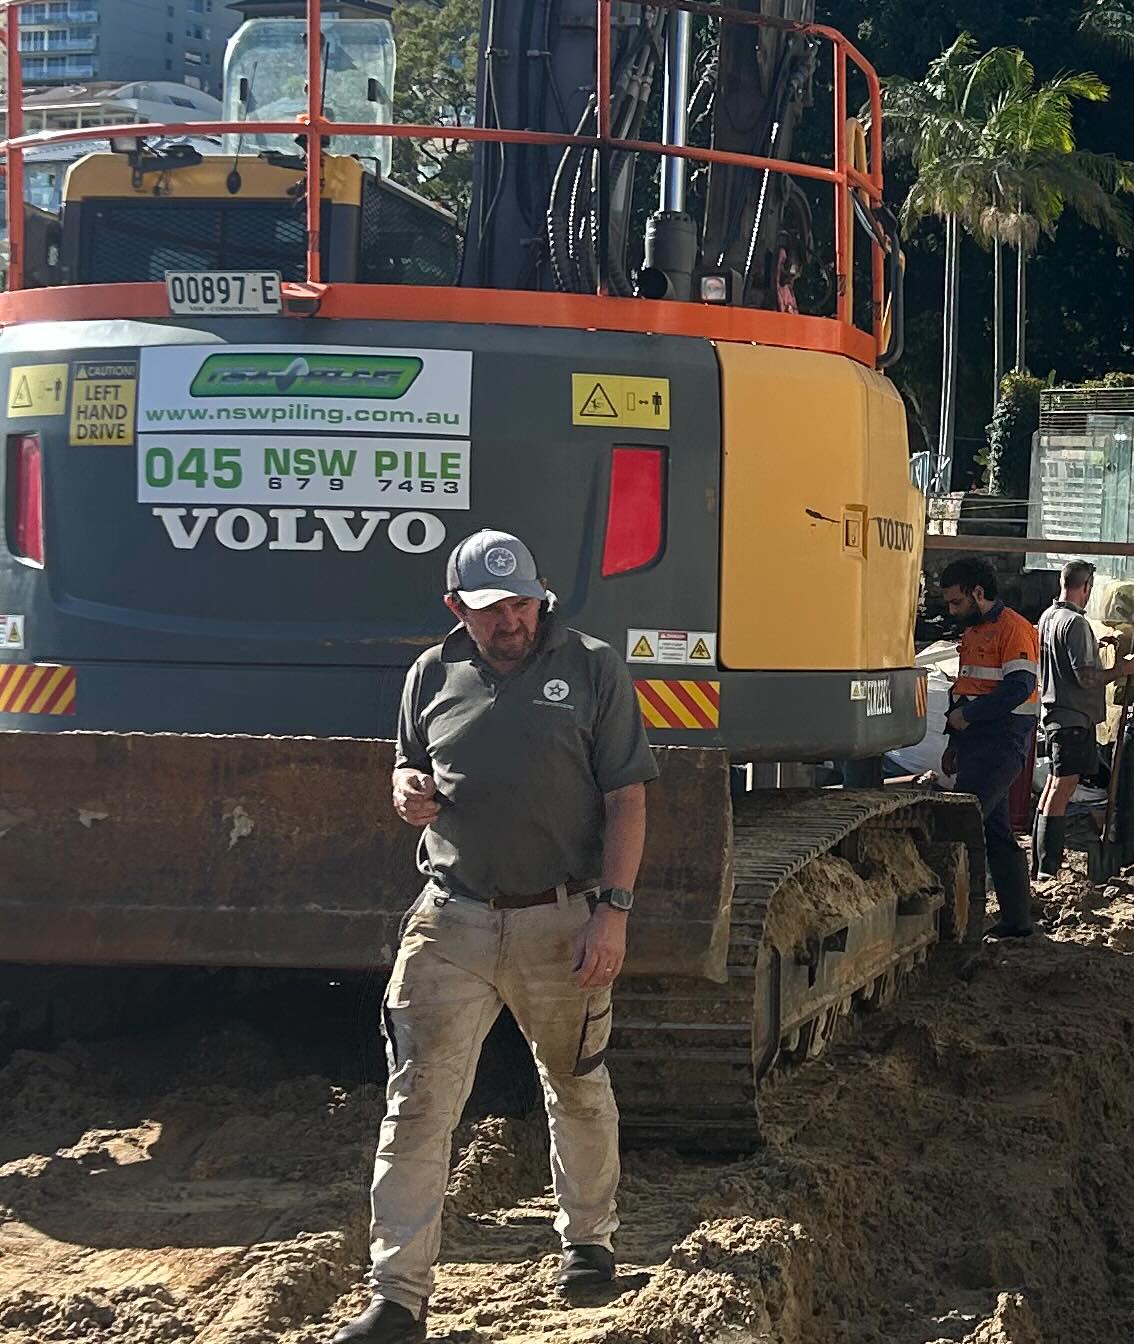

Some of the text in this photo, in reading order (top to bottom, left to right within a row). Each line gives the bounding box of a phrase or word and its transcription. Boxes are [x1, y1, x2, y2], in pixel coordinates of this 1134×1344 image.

[85, 384, 122, 401] LEFT
[76, 404, 128, 421] HAND
[145, 403, 460, 425] www.nswpiling.com.au
[76, 423, 126, 440] DRIVE
[144, 446, 462, 489] 045 NSW PILE
[152, 507, 447, 554] VOLVO
[876, 516, 914, 553] VOLVO
